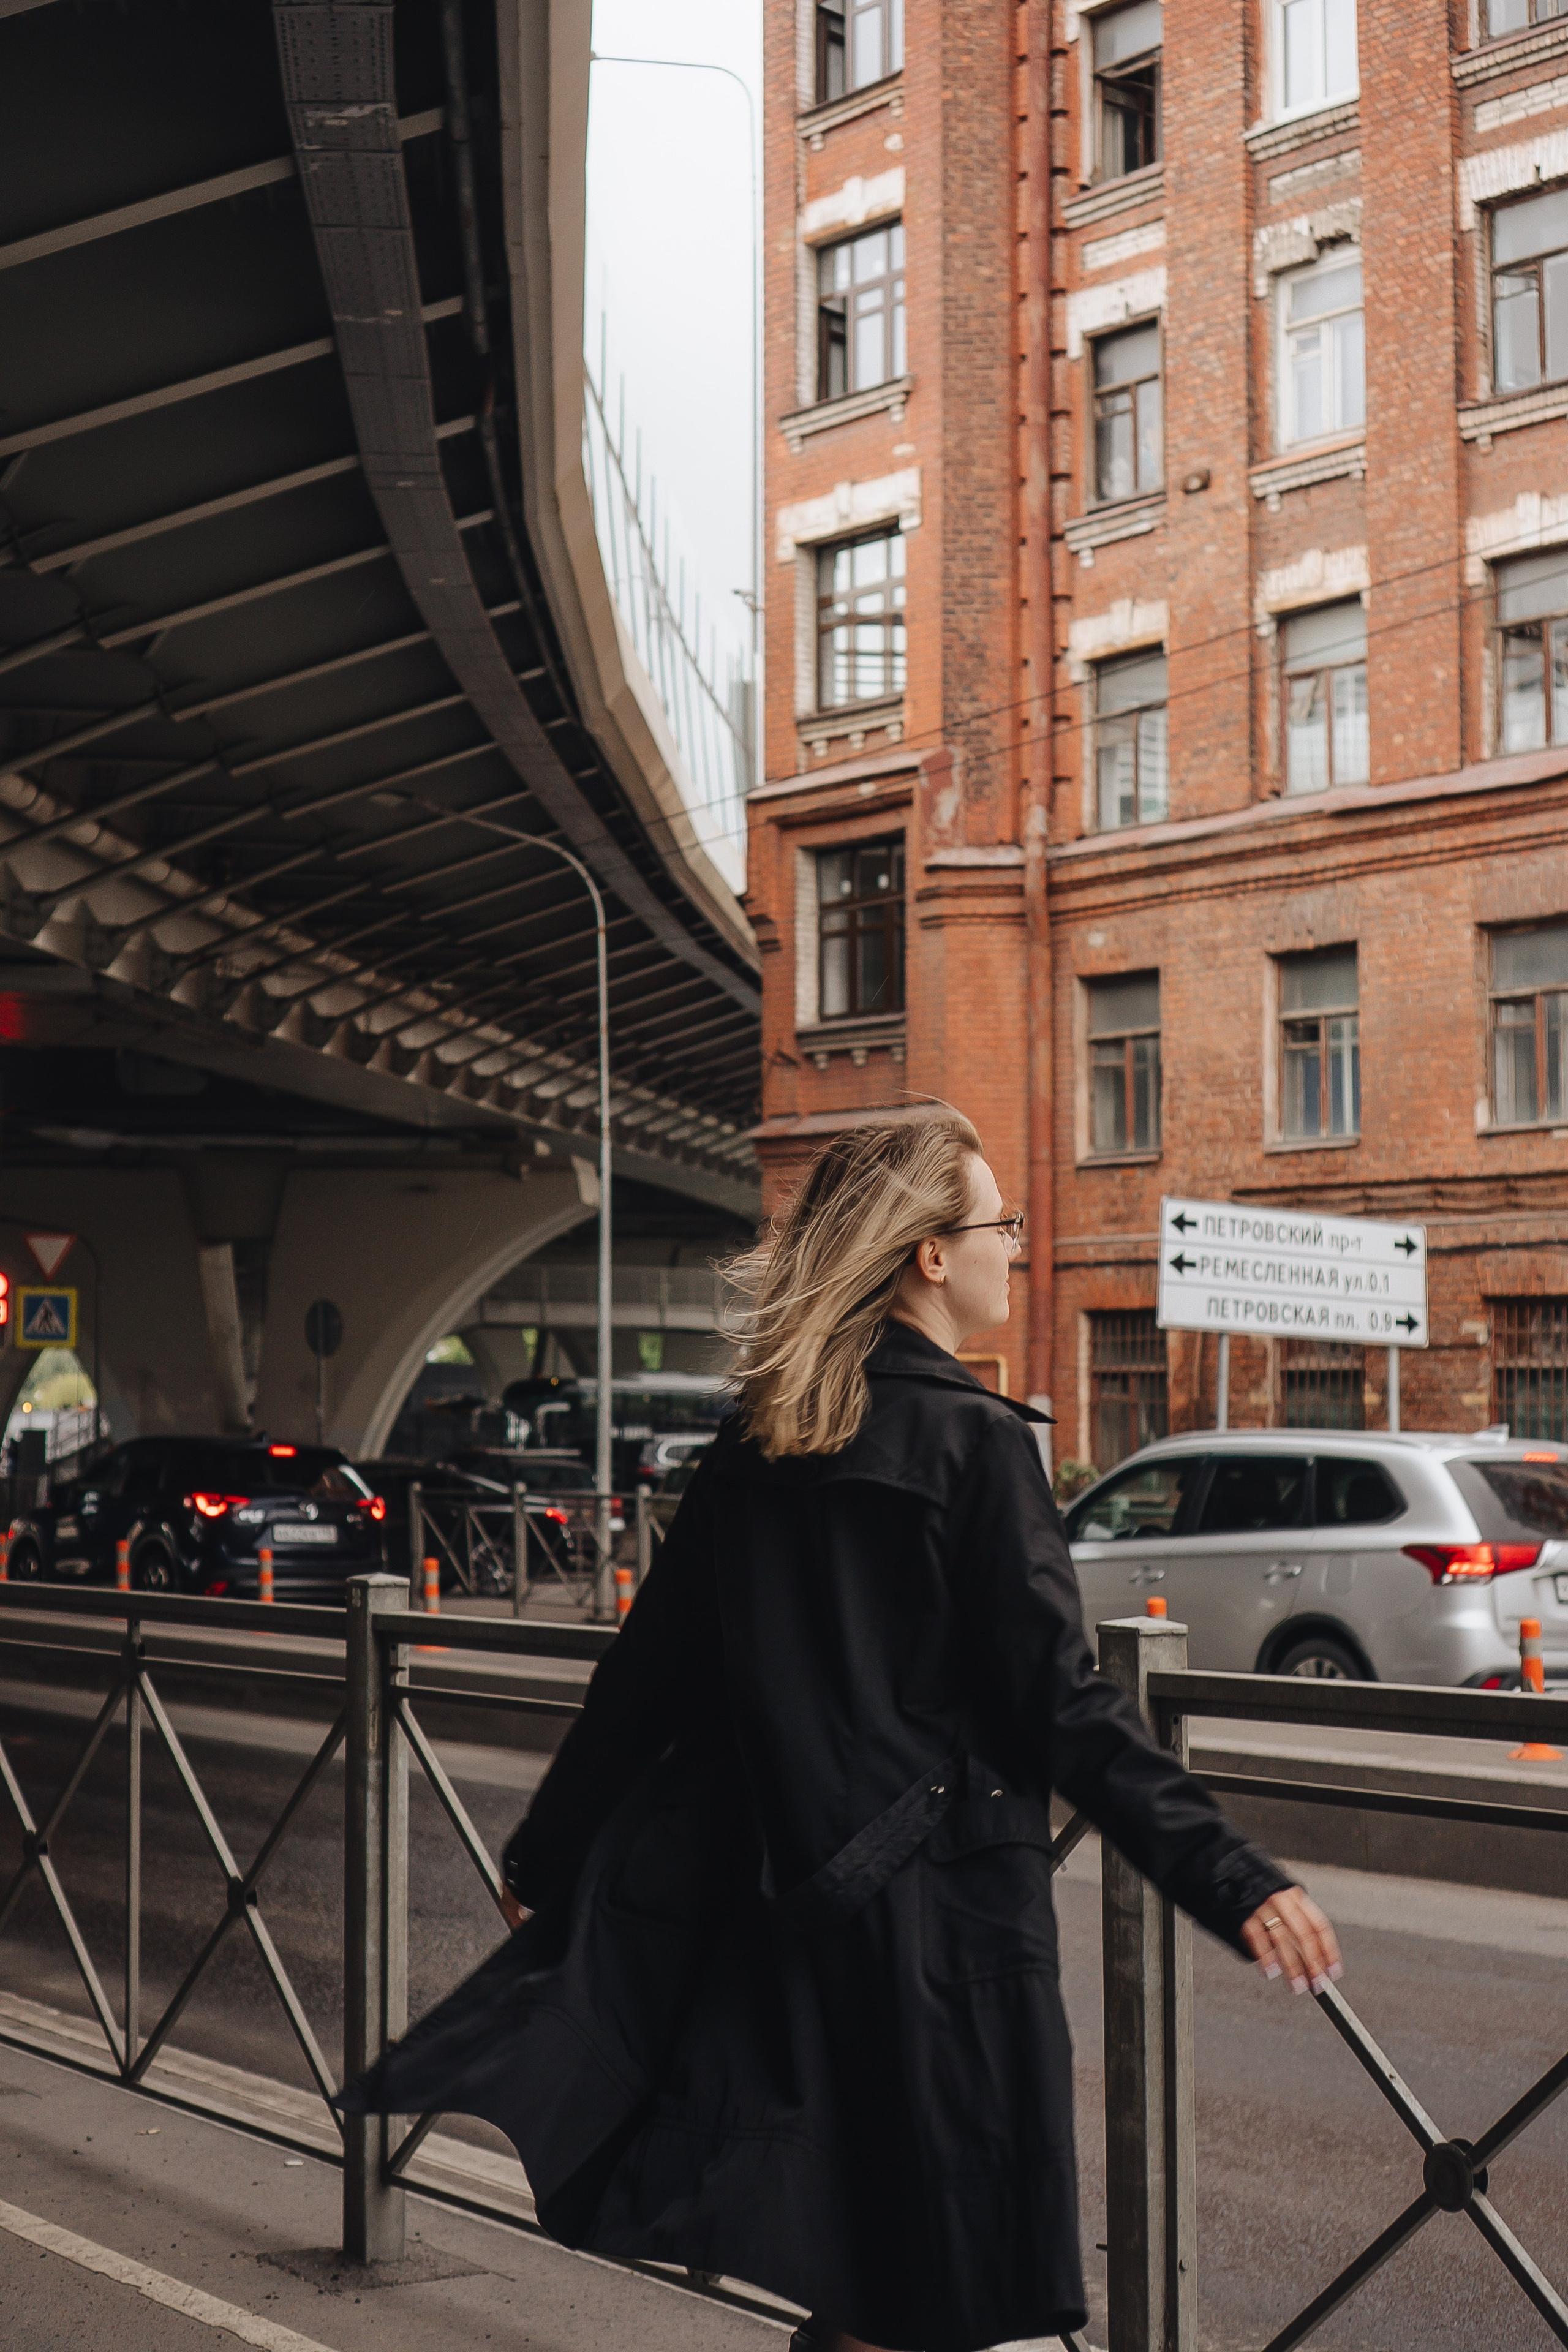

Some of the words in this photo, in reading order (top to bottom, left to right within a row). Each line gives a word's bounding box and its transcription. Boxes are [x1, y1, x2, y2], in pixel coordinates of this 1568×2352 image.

[1204, 1215, 1323, 1246] ПЕТРОВСКИЙ
[1200, 1256, 1339, 1287] РЕМЕСЛЕННАЯ
[1207, 1297, 1330, 1327] ПЕТРОВСКАЯ
